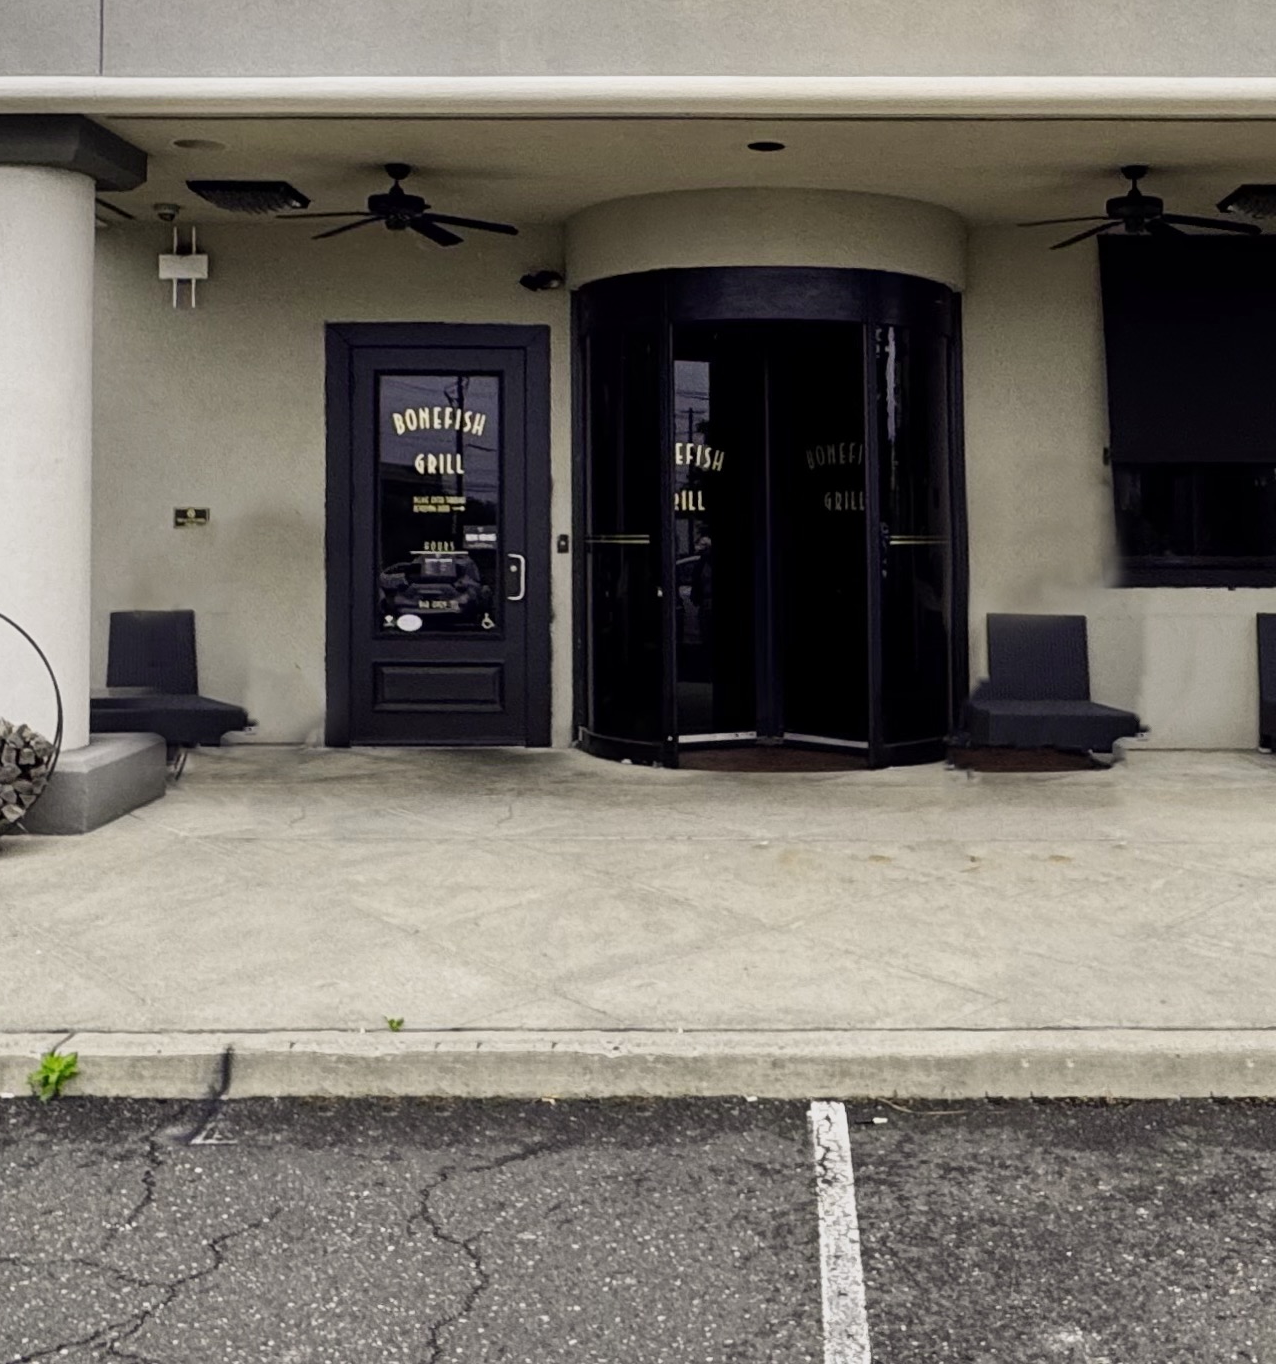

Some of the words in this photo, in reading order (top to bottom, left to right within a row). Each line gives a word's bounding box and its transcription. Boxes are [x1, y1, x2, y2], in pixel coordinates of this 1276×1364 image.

[392, 406, 486, 436] BONEFISH
[414, 453, 465, 475] GRILL
[675, 442, 725, 472] EFISH
[805, 442, 863, 471] BONEFI
[674, 489, 706, 511] RILL
[823, 490, 865, 511] GRILL
